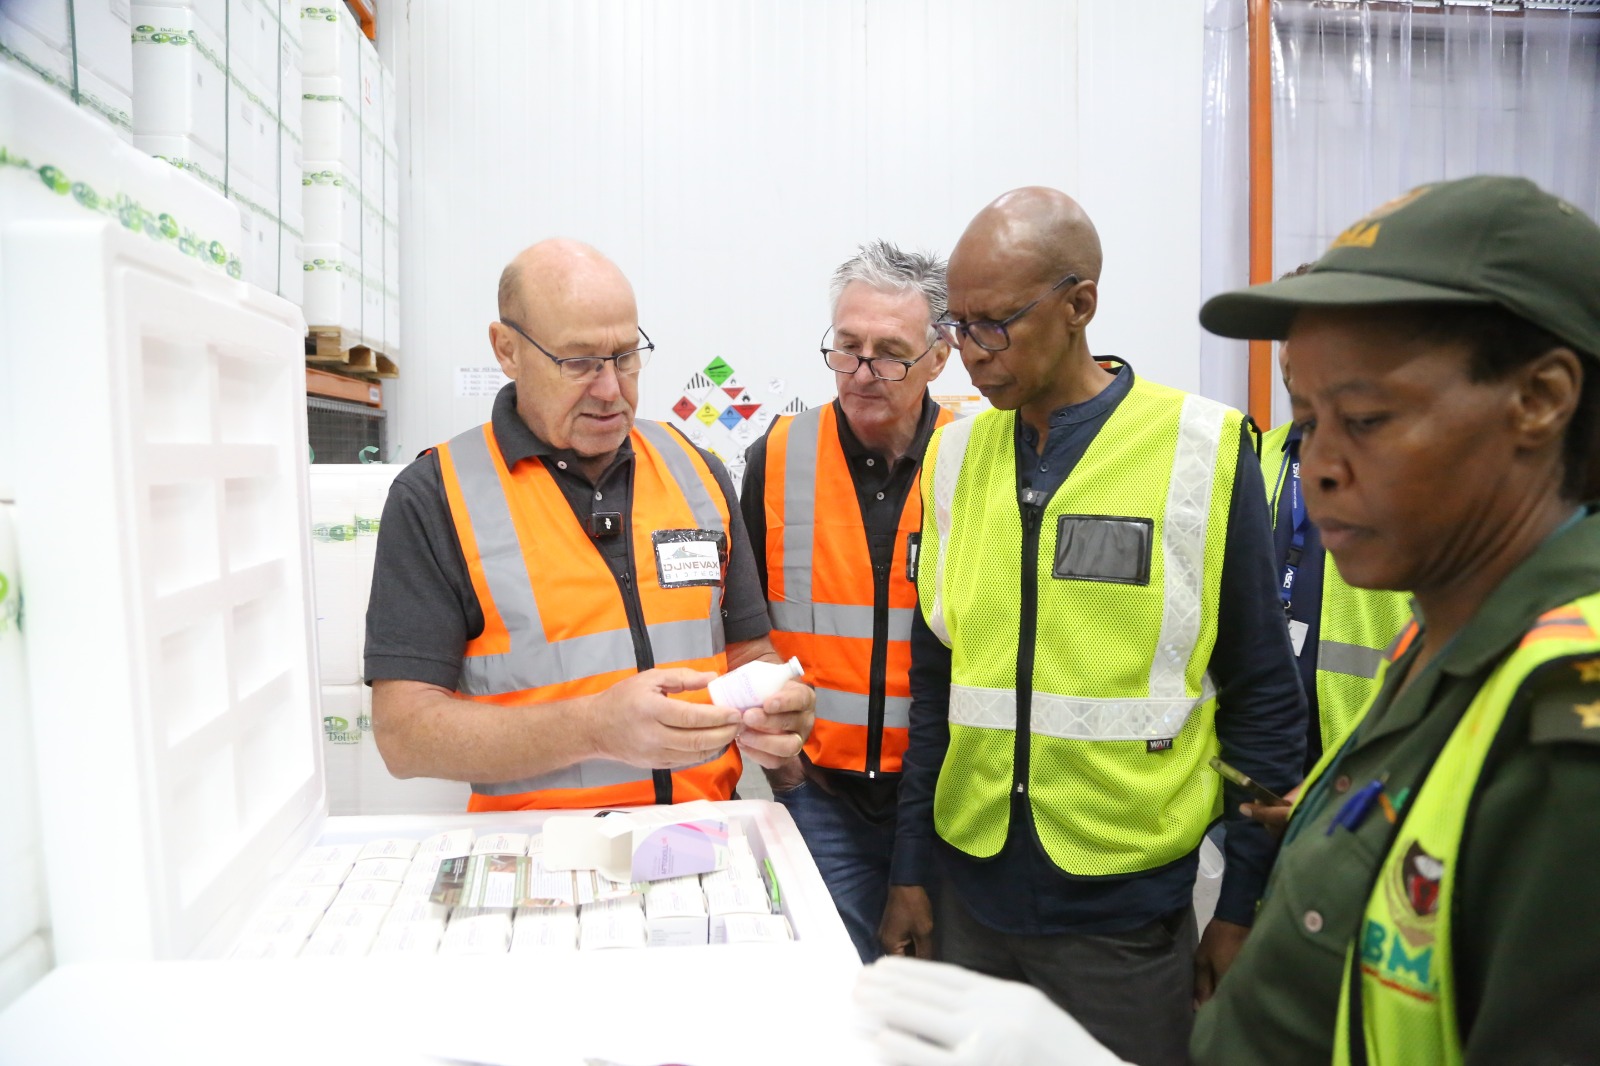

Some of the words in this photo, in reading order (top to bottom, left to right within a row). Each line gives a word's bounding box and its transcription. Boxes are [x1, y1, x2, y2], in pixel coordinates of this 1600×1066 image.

[1292, 462, 1301, 479] DSV
[663, 561, 719, 572] DUNEVAX
[665, 570, 721, 580] BIOTECH
[1283, 568, 1294, 589] DSV
[1150, 739, 1172, 749] WATT
